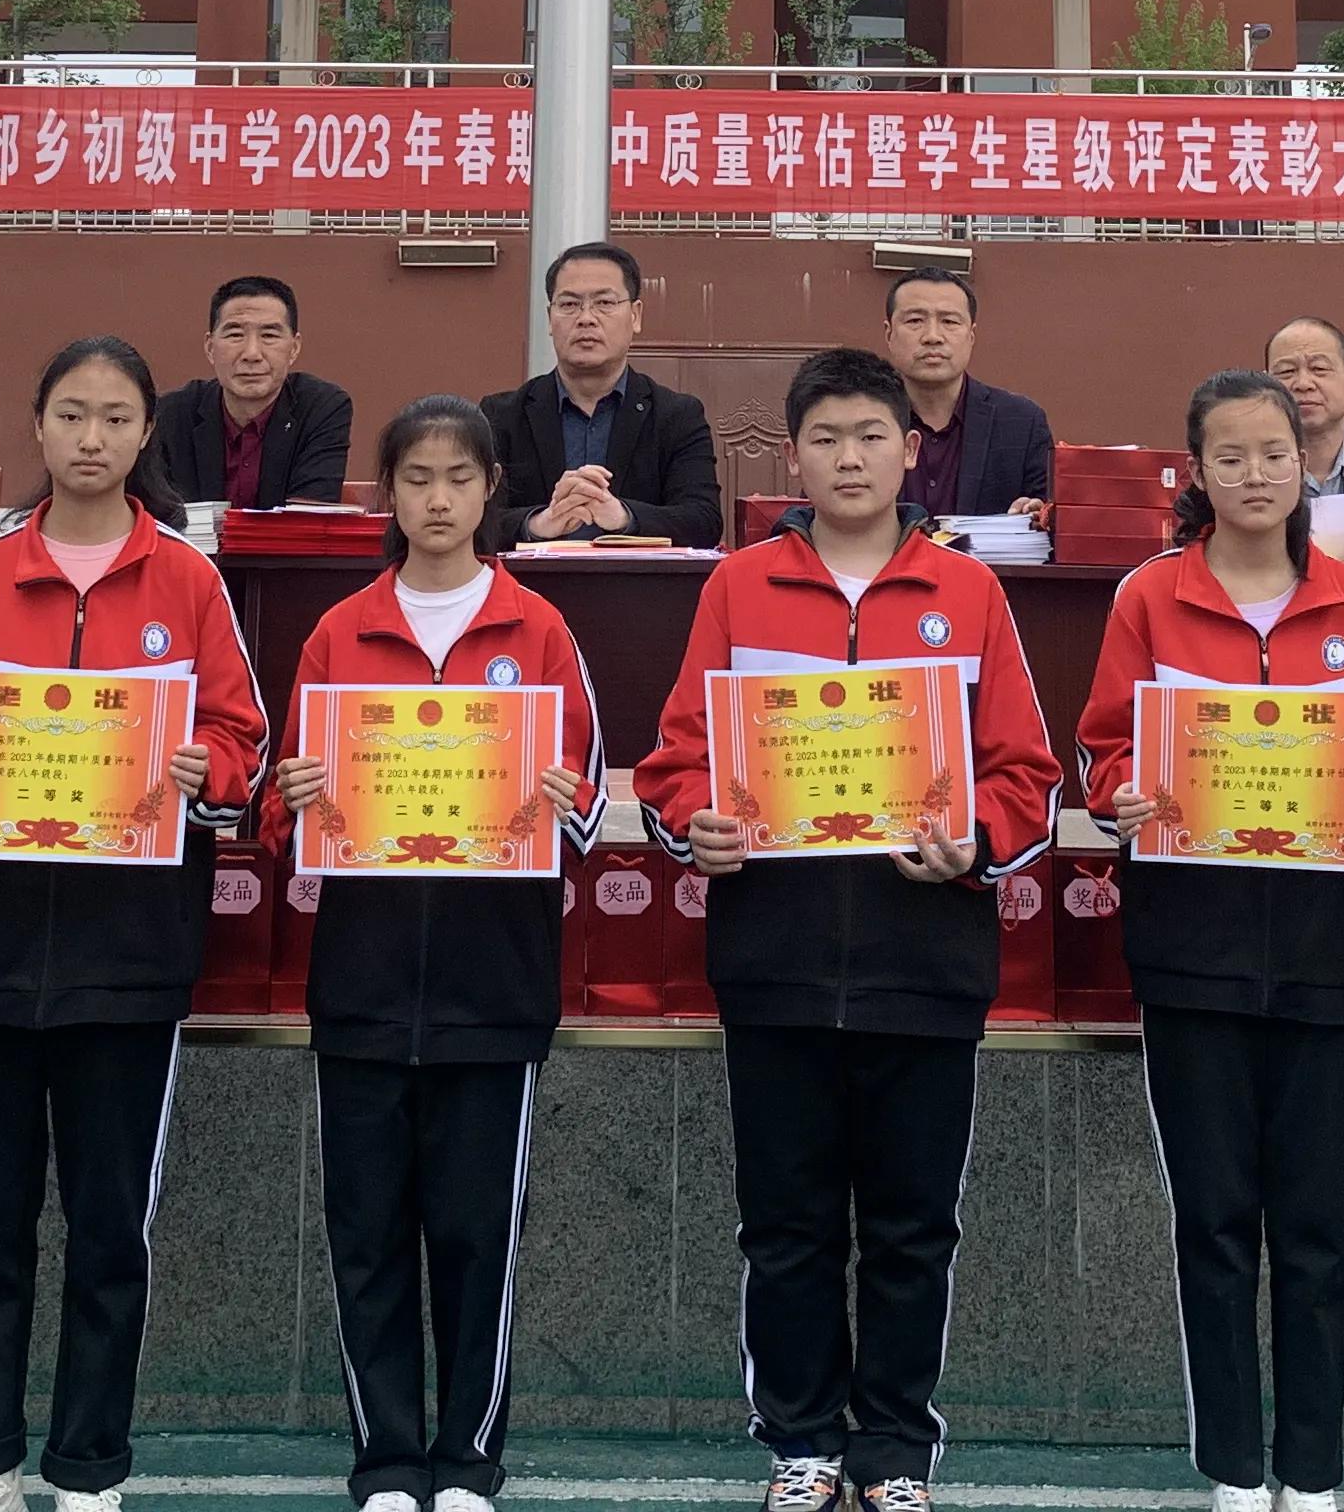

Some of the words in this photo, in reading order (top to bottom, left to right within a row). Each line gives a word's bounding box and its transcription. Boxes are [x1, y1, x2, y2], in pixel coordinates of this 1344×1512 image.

[17, 788, 84, 803] 二等奖
[808, 783, 874, 797] 二等奖
[396, 804, 461, 818] 二等奖
[1233, 799, 1298, 813] 二等奖
[602, 880, 644, 904] 奖品
